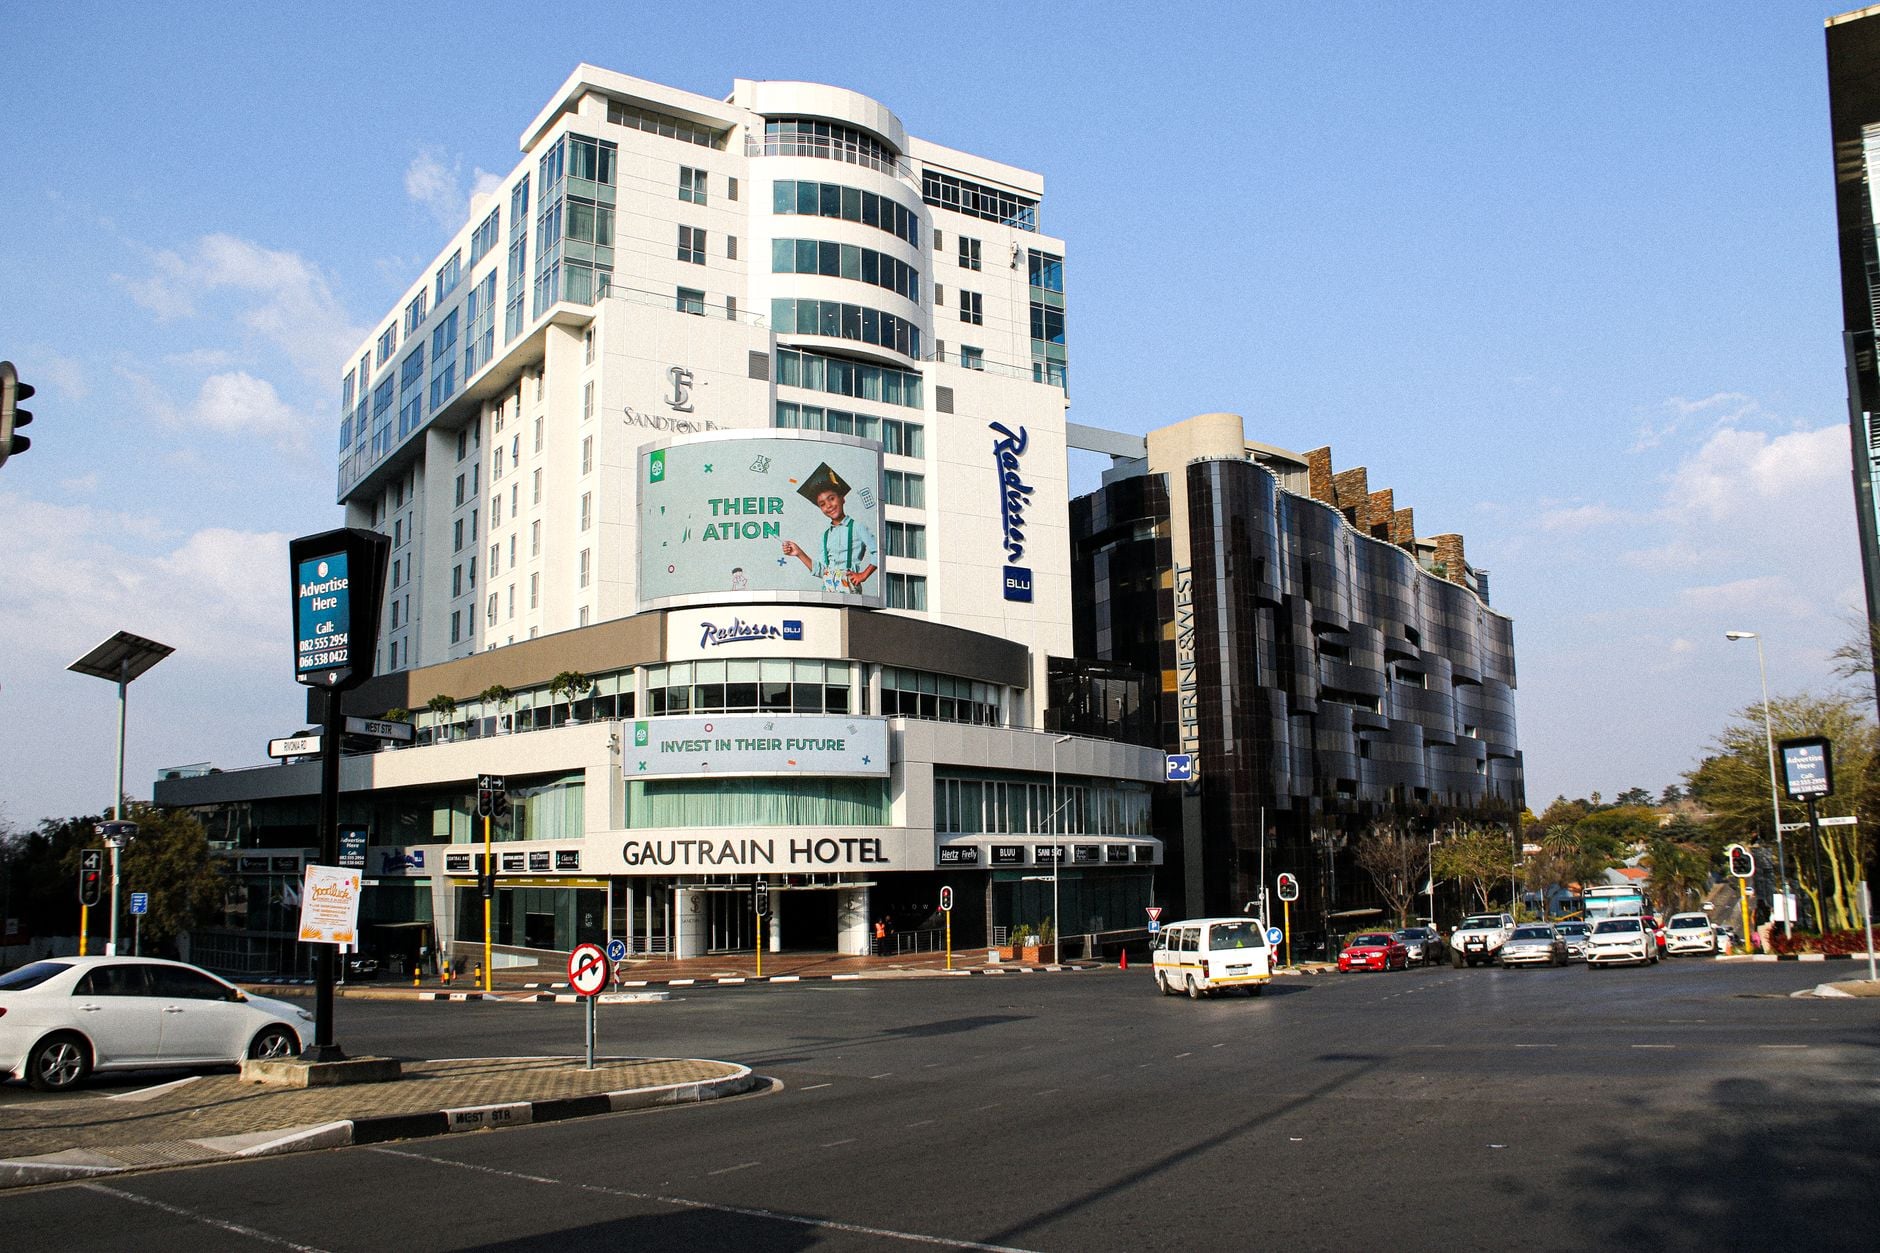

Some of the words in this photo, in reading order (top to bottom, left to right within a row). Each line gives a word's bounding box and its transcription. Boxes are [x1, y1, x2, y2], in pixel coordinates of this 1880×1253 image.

[988, 421, 1034, 563] Radisson
[708, 496, 784, 517] THEIR
[299, 577, 349, 598] Advertise
[1006, 578, 1031, 590] BLU
[312, 597, 338, 611] Here
[316, 621, 335, 635] Call:
[700, 616, 782, 649] Radisson
[299, 639, 314, 652] 082
[314, 636, 329, 650] 555
[329, 633, 348, 647] 2954
[299, 655, 314, 668] 066
[314, 652, 329, 666] 538
[329, 649, 348, 663] 0422
[365, 721, 380, 733] WEST
[381, 724, 393, 735] STR
[660, 739, 711, 753] INVEST
[715, 739, 732, 752] IN
[735, 738, 782, 751] THEIR
[786, 738, 846, 752] FUTURE
[622, 839, 774, 866] GAUTRAIN
[790, 838, 889, 864] HOTEL
[941, 849, 959, 860] Hertz
[456, 1111, 484, 1124] WEST
[491, 1109, 512, 1121] STR
